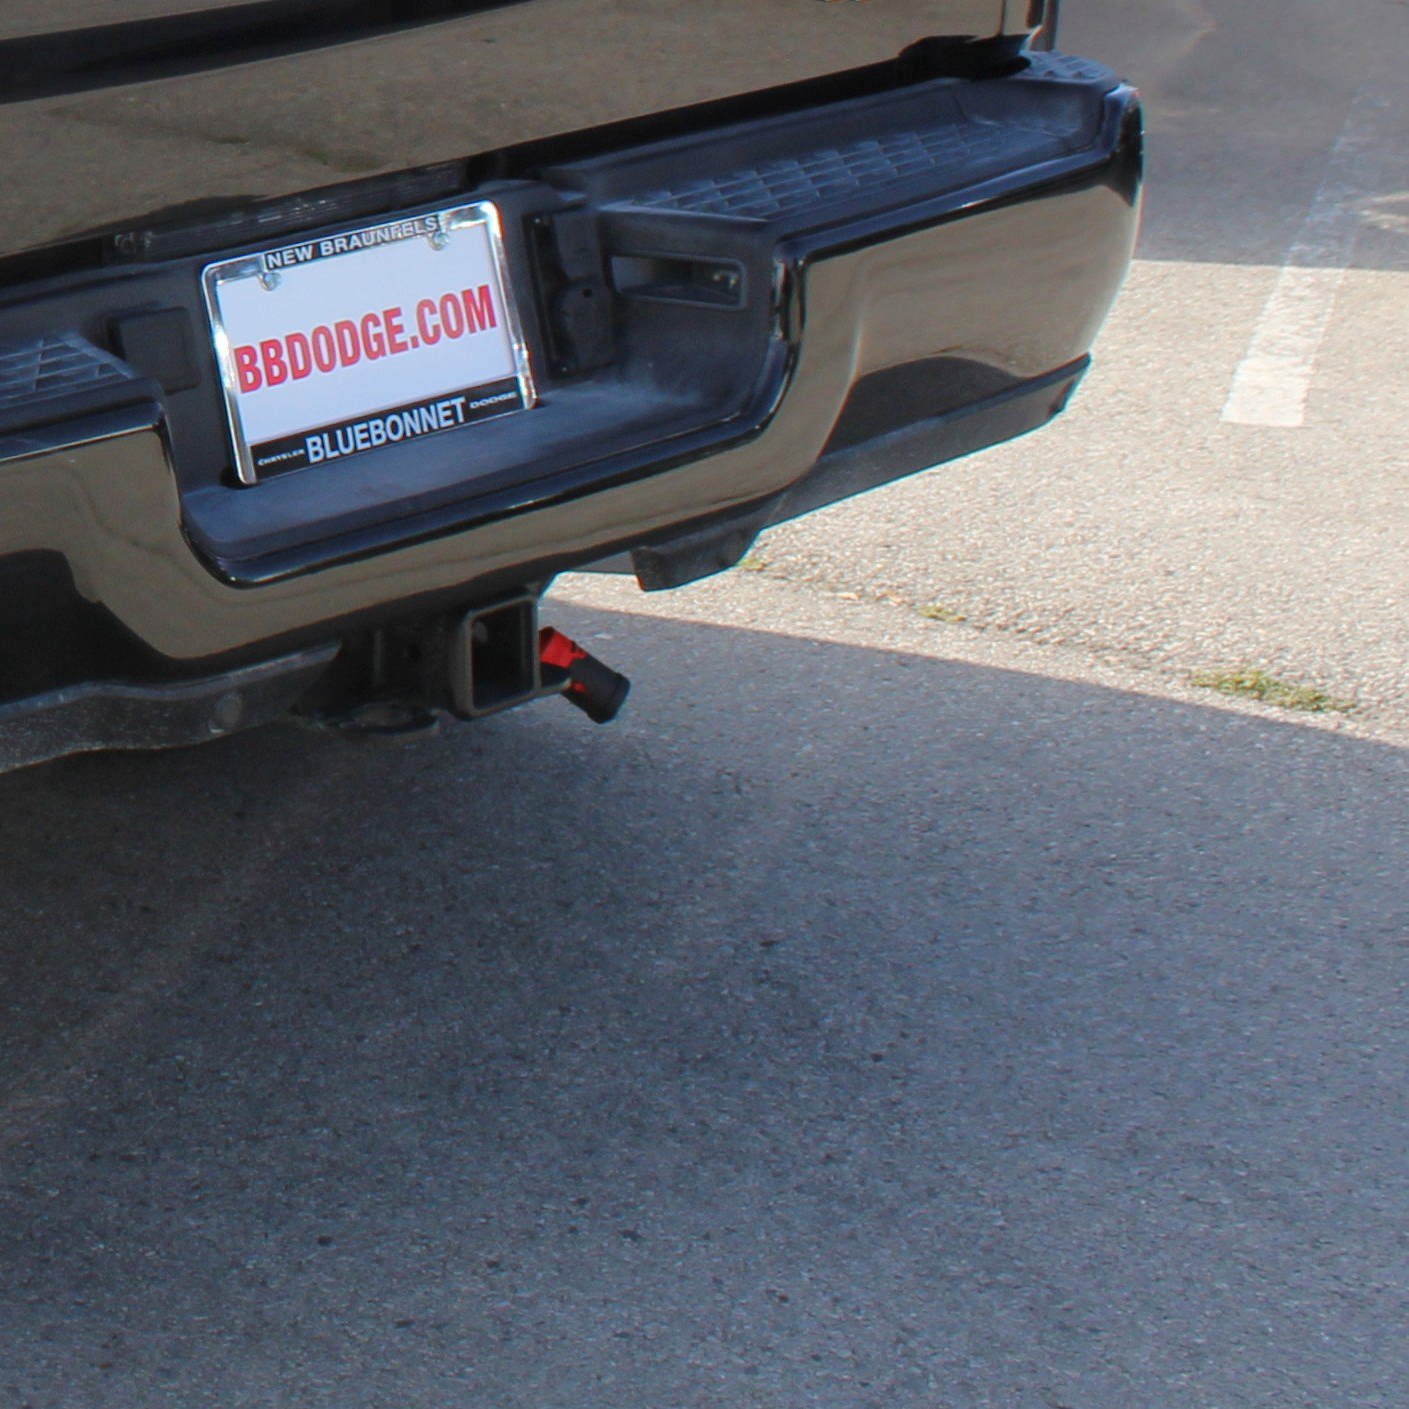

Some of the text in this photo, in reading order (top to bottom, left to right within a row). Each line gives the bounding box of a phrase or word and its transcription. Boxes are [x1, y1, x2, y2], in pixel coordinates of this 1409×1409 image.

[267, 217, 437, 268] NEW BRAUNFELS
[234, 285, 497, 393] BBDODGE.COM
[305, 397, 466, 463] BLUEBONNET
